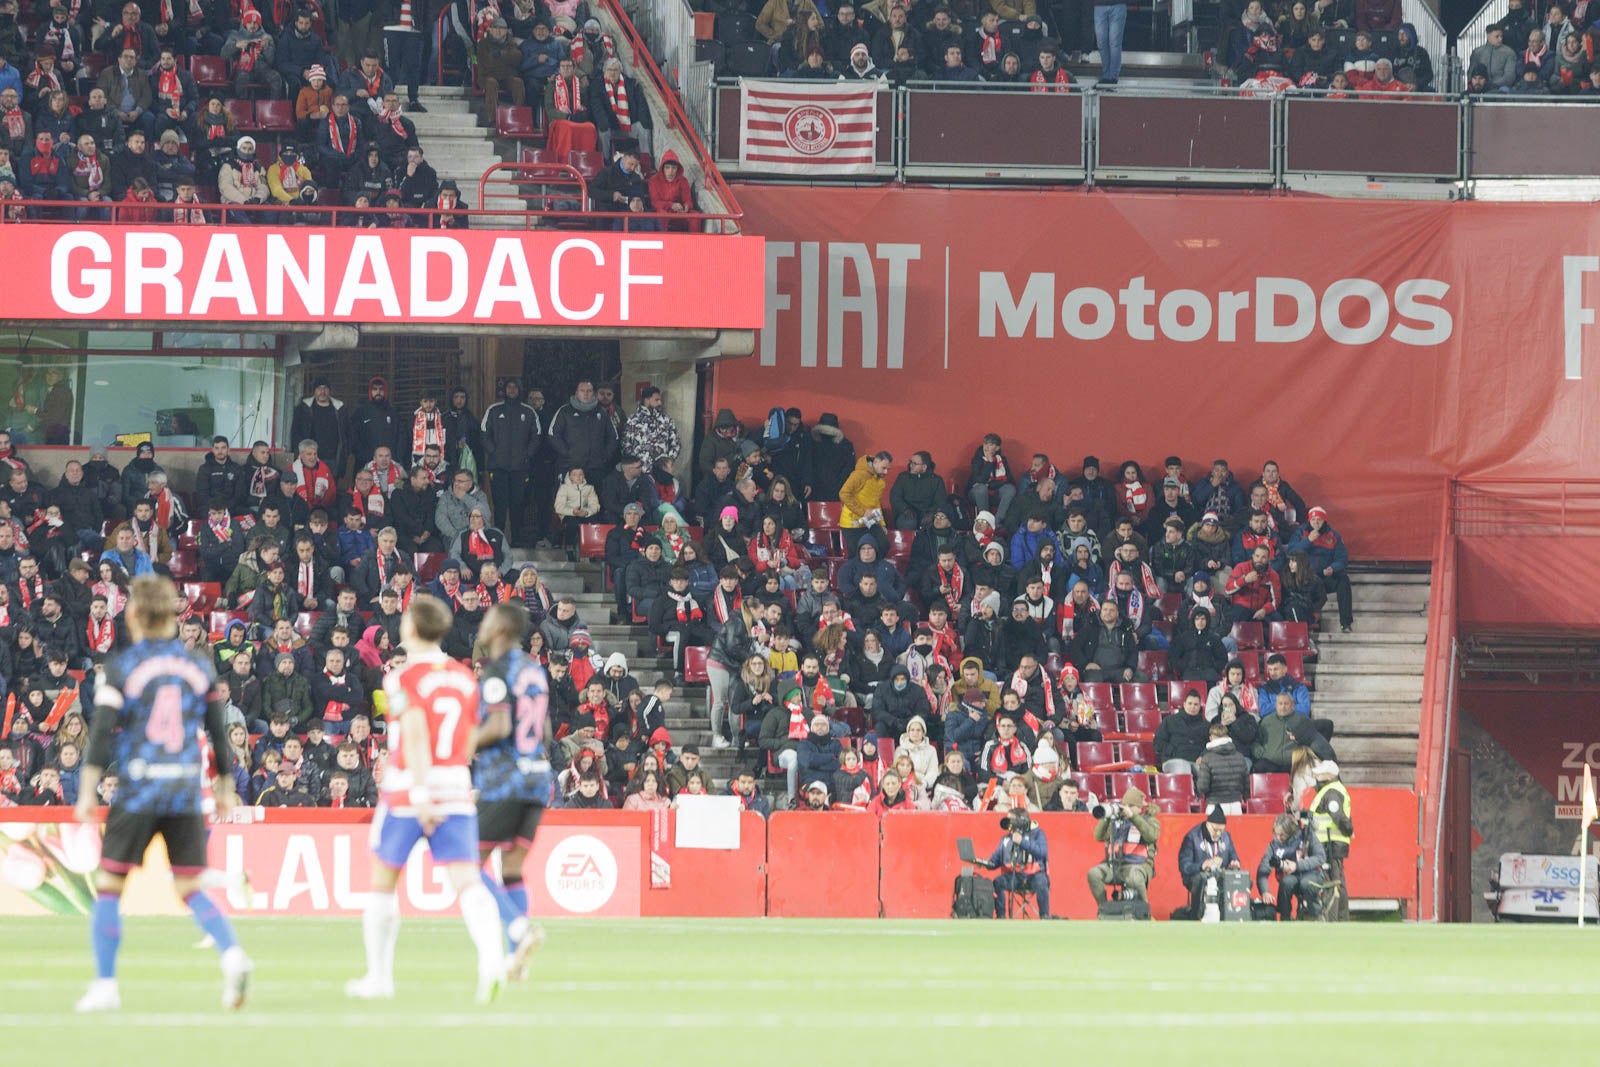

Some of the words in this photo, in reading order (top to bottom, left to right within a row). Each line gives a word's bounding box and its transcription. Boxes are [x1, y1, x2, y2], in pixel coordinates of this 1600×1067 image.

[760, 240, 921, 369] FIAT
[978, 271, 1454, 347] MotorDOS
[145, 684, 185, 754] 4
[432, 696, 462, 759] 7
[558, 879, 605, 890] SPORTS
[560, 853, 602, 877] EA
